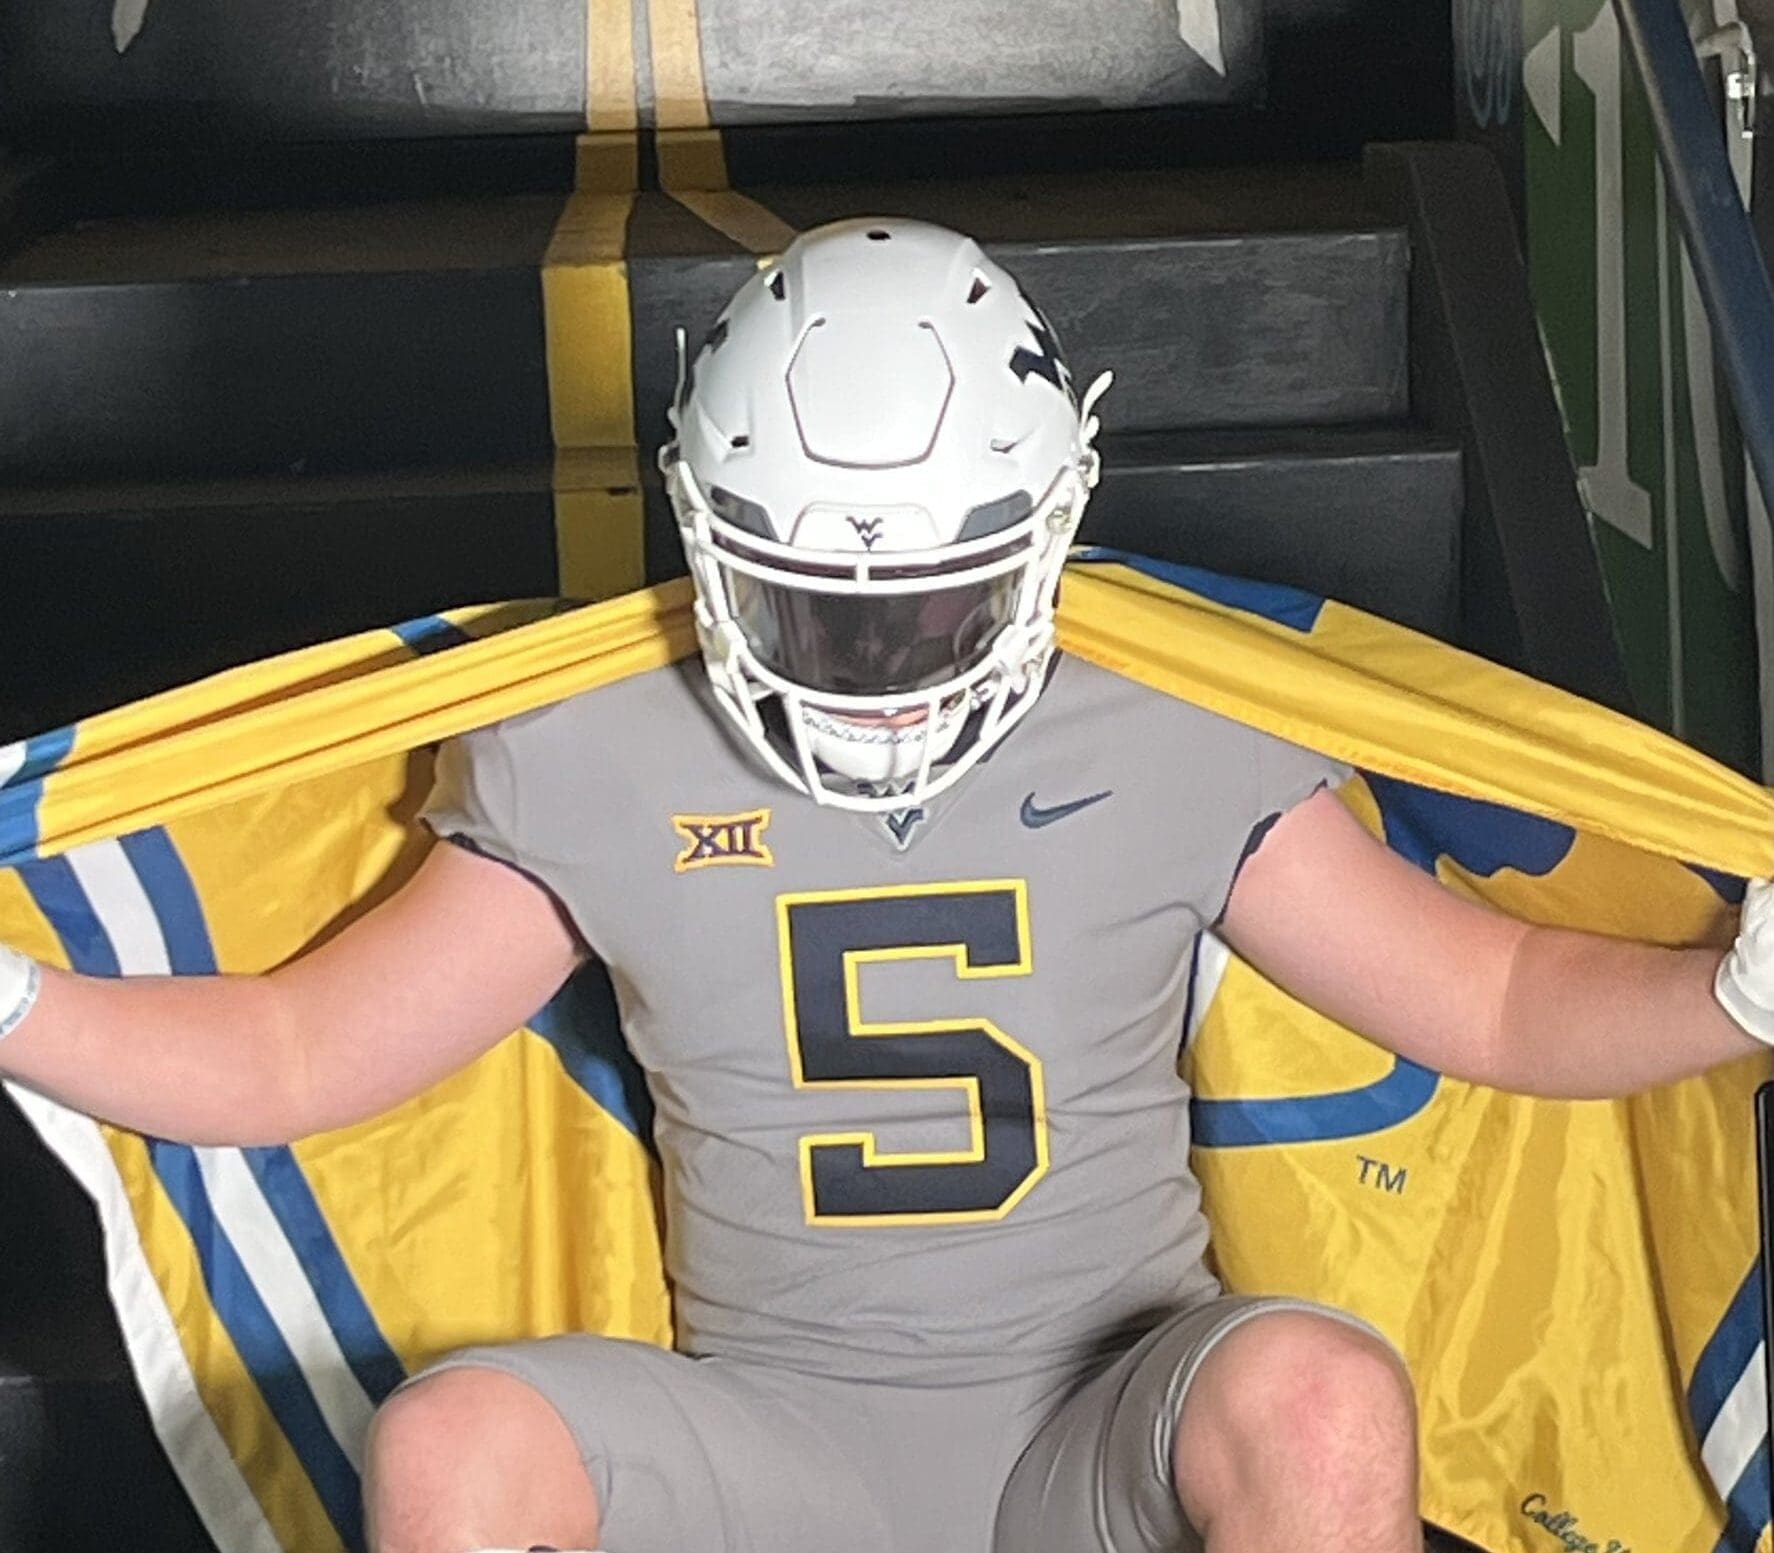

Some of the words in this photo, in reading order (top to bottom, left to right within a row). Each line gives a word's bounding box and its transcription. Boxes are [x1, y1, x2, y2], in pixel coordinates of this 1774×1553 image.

[677, 813, 768, 866] XII
[776, 879, 1050, 1227] 5
[1355, 1154, 1407, 1195] TM
